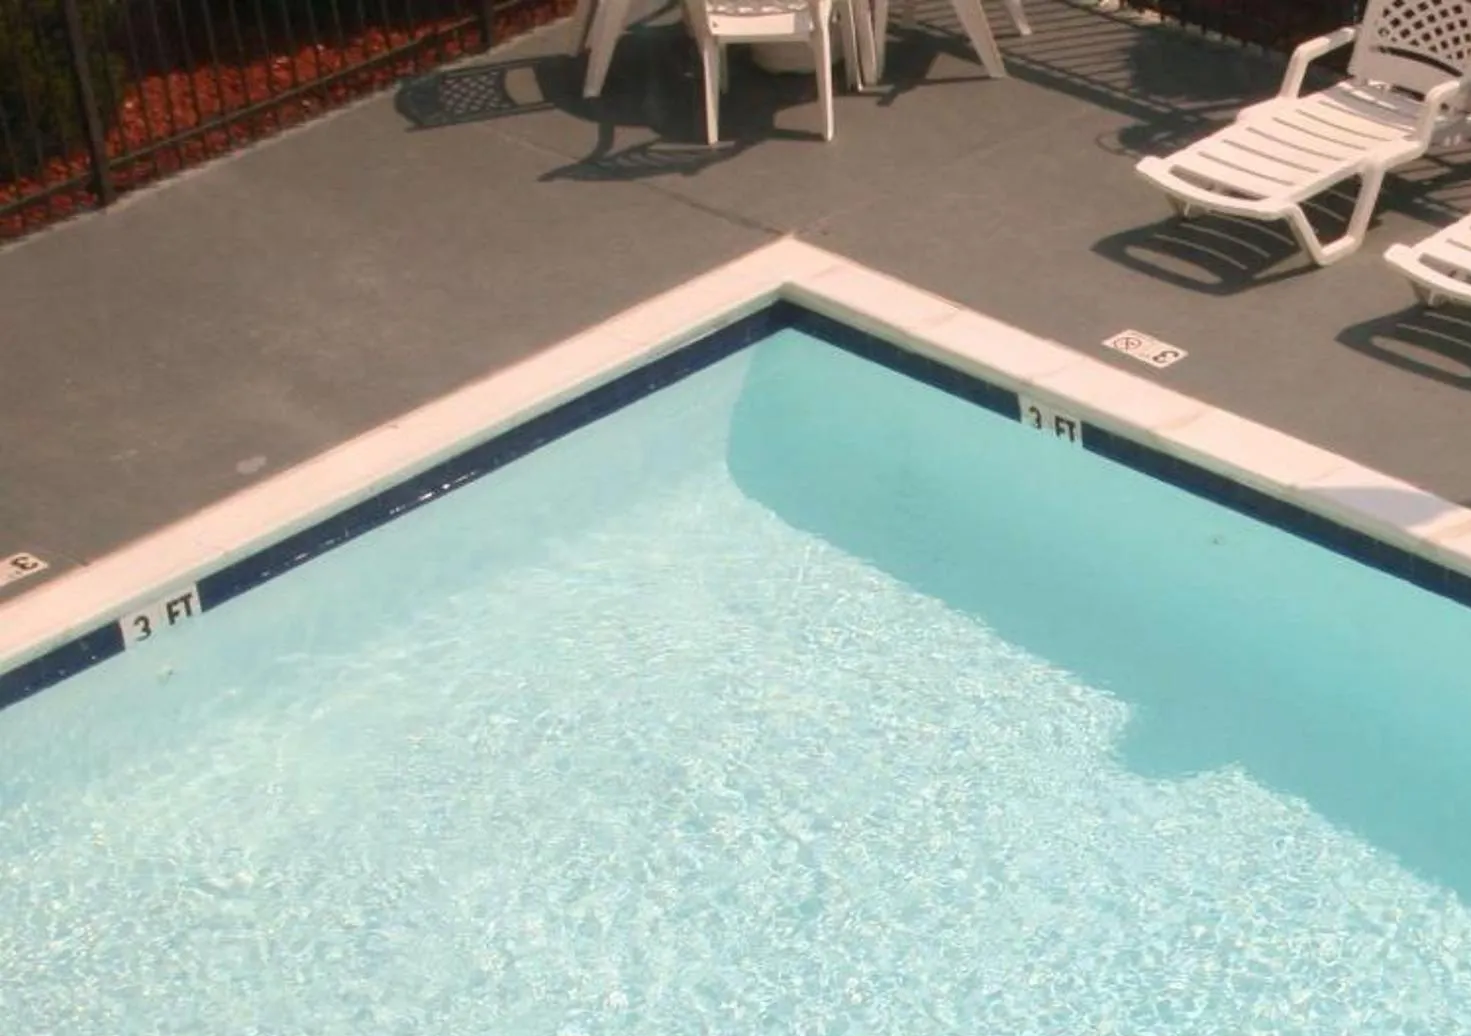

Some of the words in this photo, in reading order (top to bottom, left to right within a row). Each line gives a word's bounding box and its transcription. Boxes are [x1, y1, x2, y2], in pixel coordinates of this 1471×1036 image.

[1054, 415, 1077, 443] FT
[133, 615, 152, 642] 3
[166, 592, 194, 626] FT
